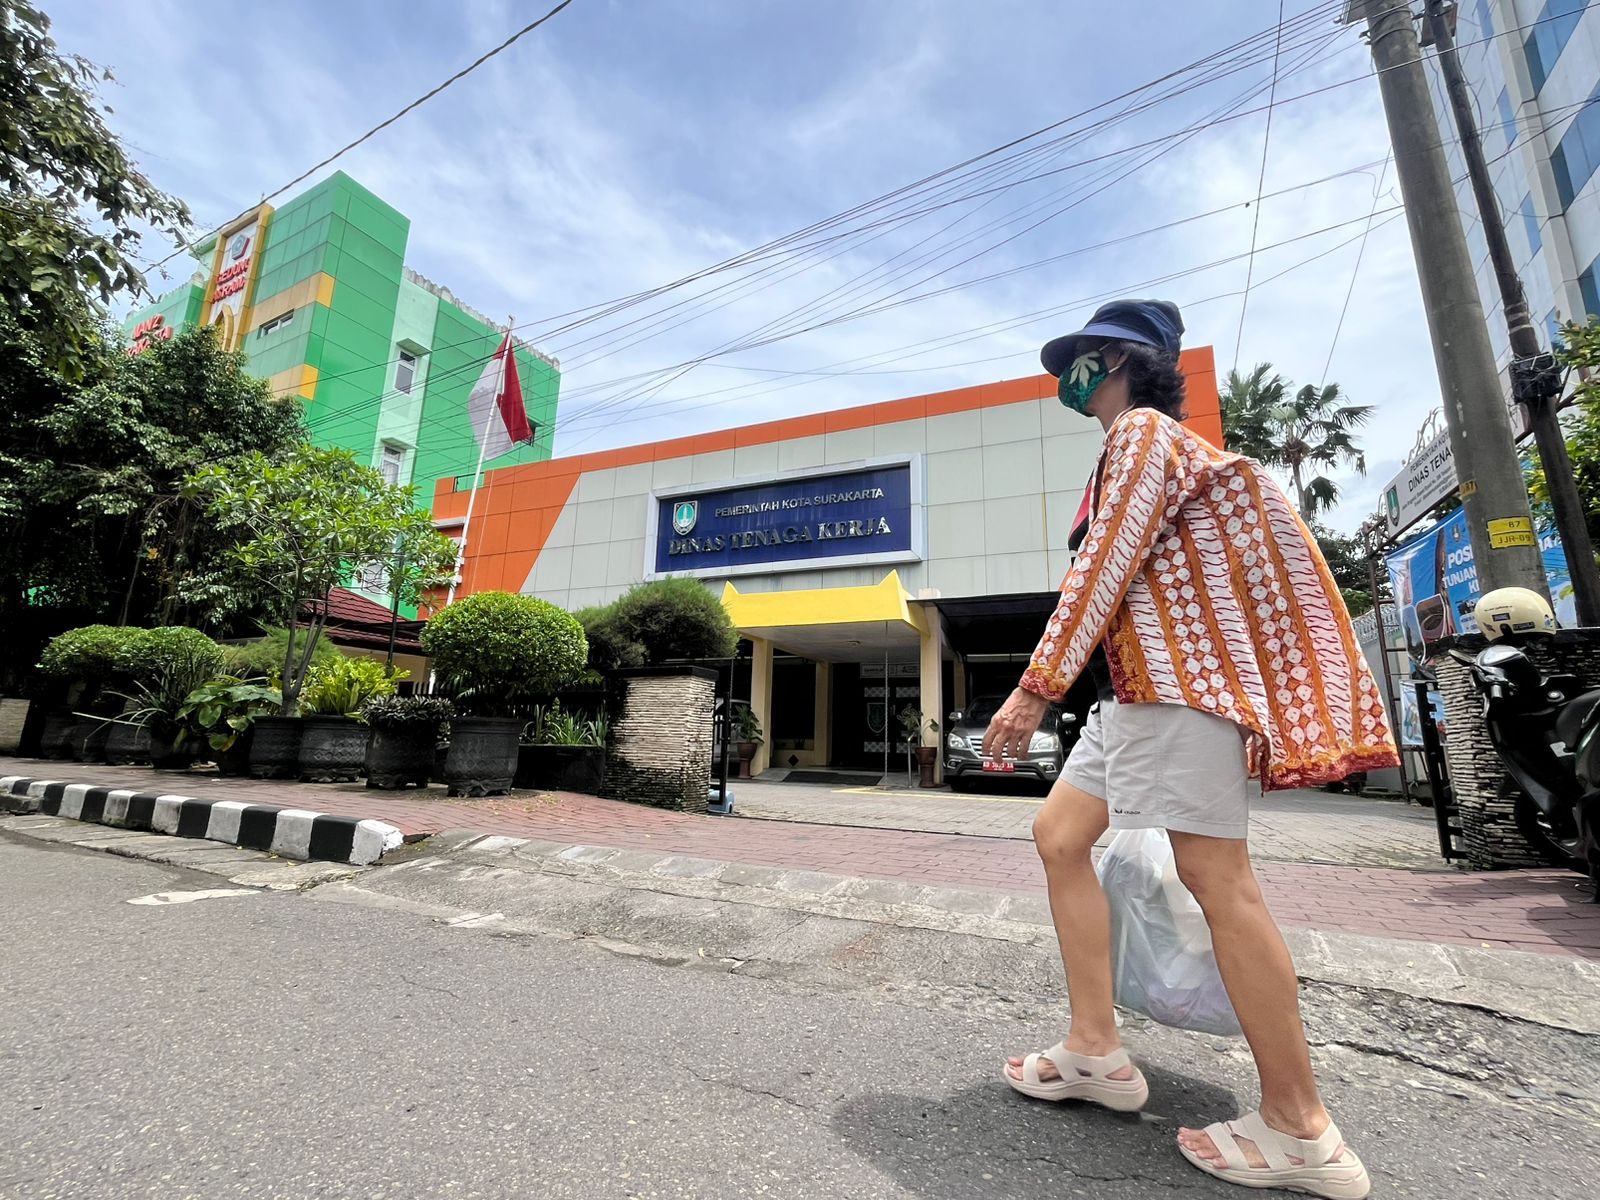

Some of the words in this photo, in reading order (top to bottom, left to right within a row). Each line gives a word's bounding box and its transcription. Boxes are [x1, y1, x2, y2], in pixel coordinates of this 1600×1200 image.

[1408, 465, 1430, 492] DINAS
[1430, 445, 1453, 472] TENA
[714, 500, 779, 517] PEMERINTAH
[782, 496, 812, 509] KOTA
[813, 487, 884, 506] SURAKARTA
[669, 535, 726, 555] DINAS
[730, 525, 813, 550] TENAGA
[817, 516, 891, 540] KERJA
